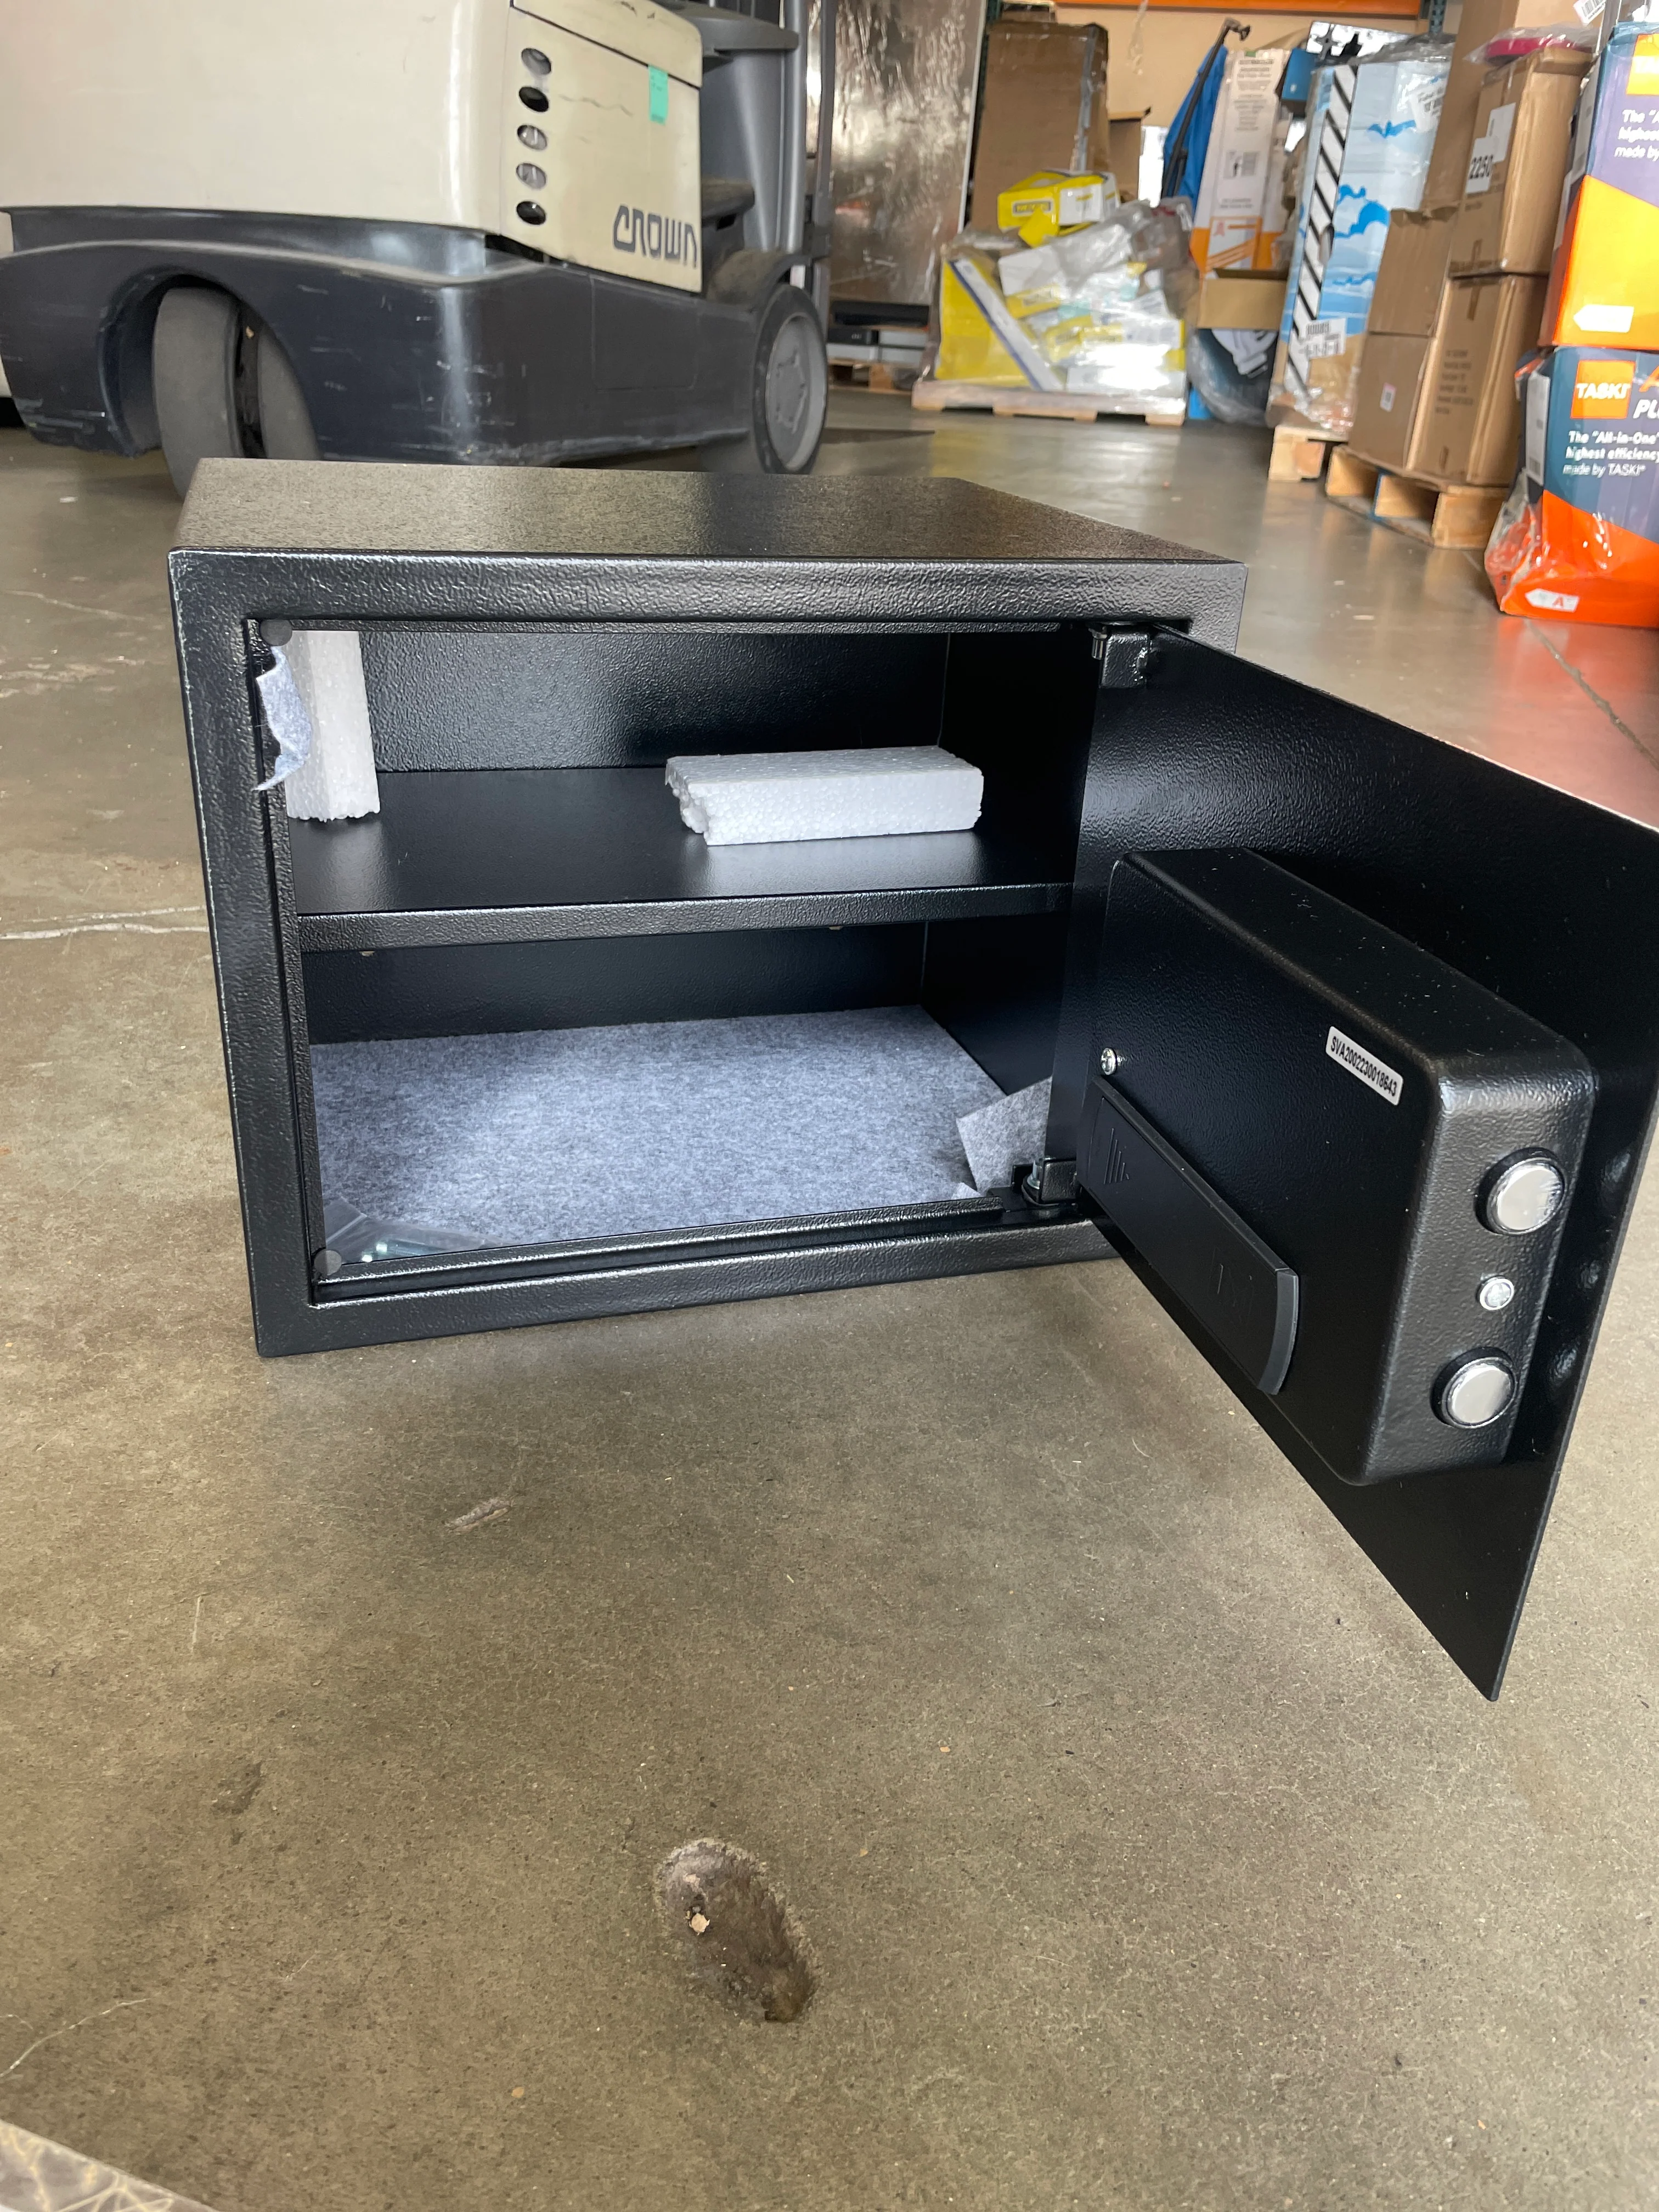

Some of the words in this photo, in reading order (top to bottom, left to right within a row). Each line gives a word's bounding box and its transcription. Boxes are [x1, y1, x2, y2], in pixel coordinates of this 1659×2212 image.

[613, 205, 697, 269] CROWN
[1568, 430, 1589, 444] The
[1565, 445, 1606, 461] highest
[1592, 463, 1606, 478] by
[1330, 1035, 1397, 1097] SVA2002230018643
